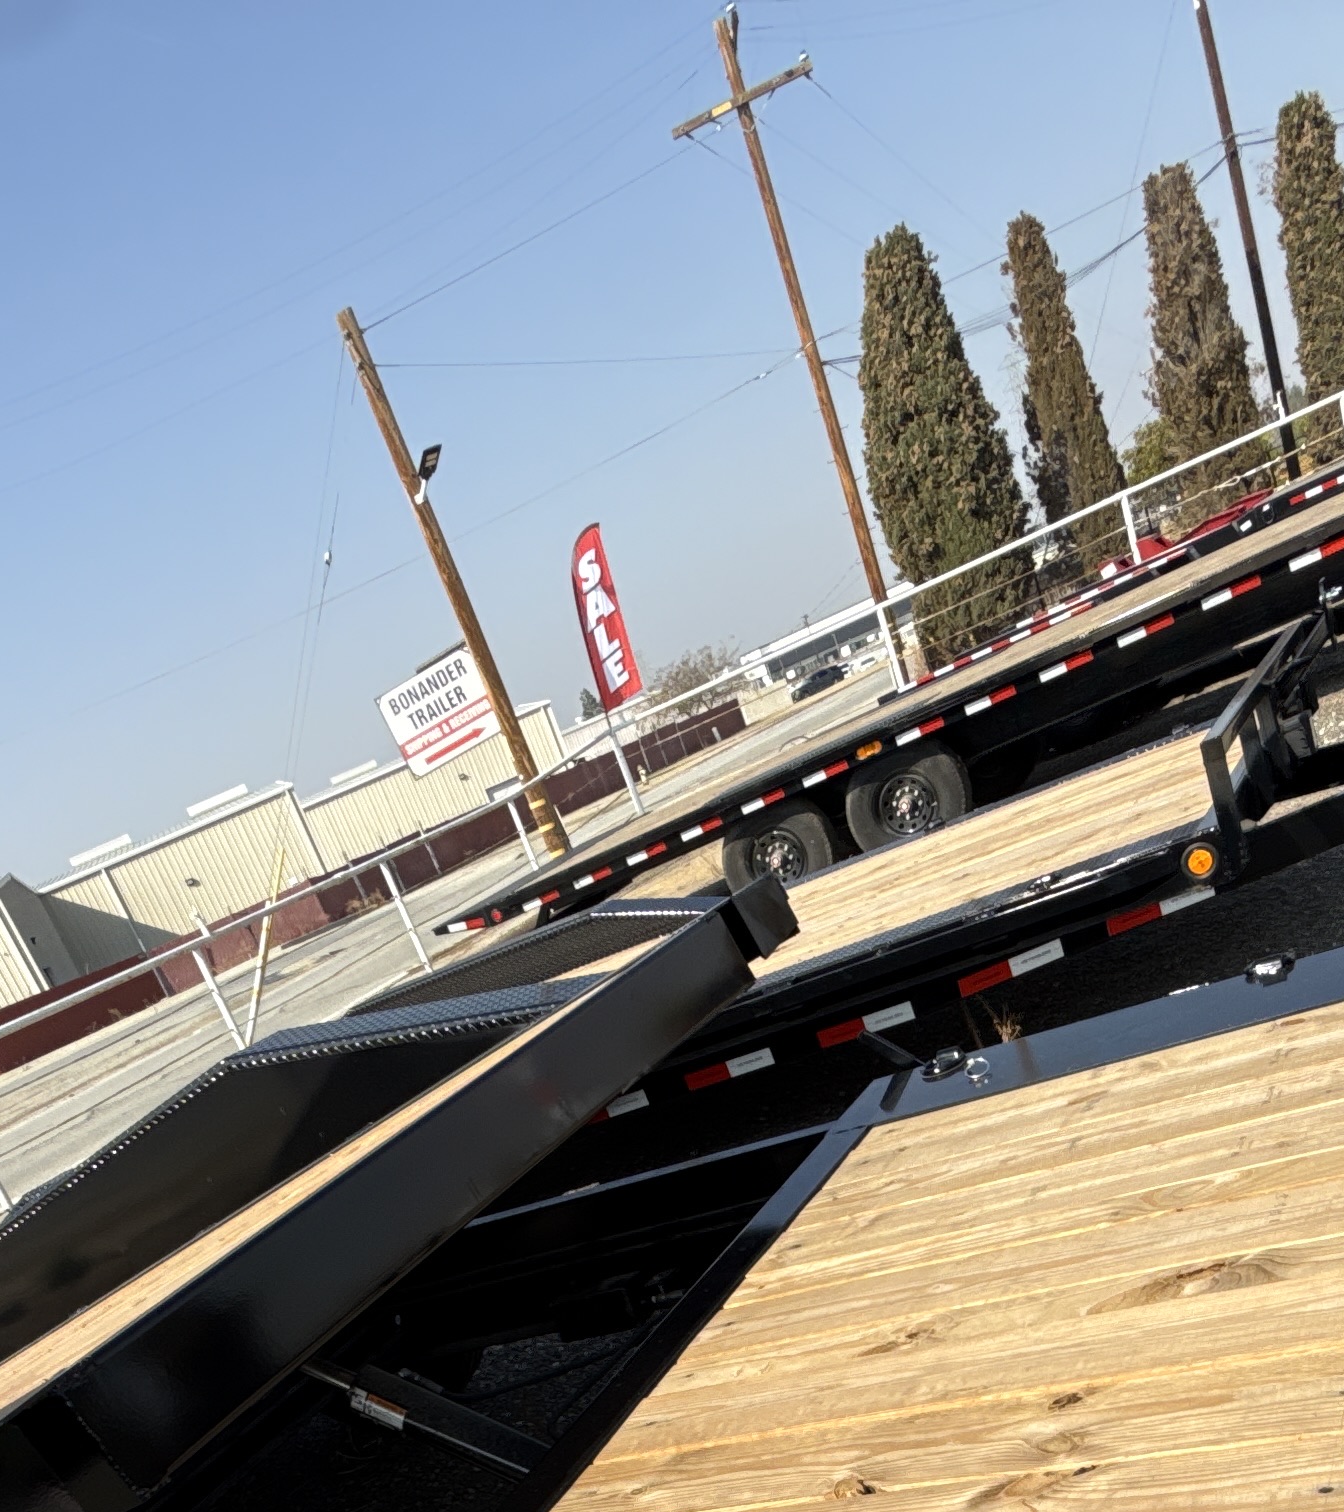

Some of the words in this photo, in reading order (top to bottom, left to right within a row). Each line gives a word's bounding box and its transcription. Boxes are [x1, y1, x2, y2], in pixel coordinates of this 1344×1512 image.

[578, 548, 630, 694] SALE
[388, 658, 468, 716] BONANDER
[407, 685, 468, 730] TRAILER
[404, 726, 444, 756] SHIPPING
